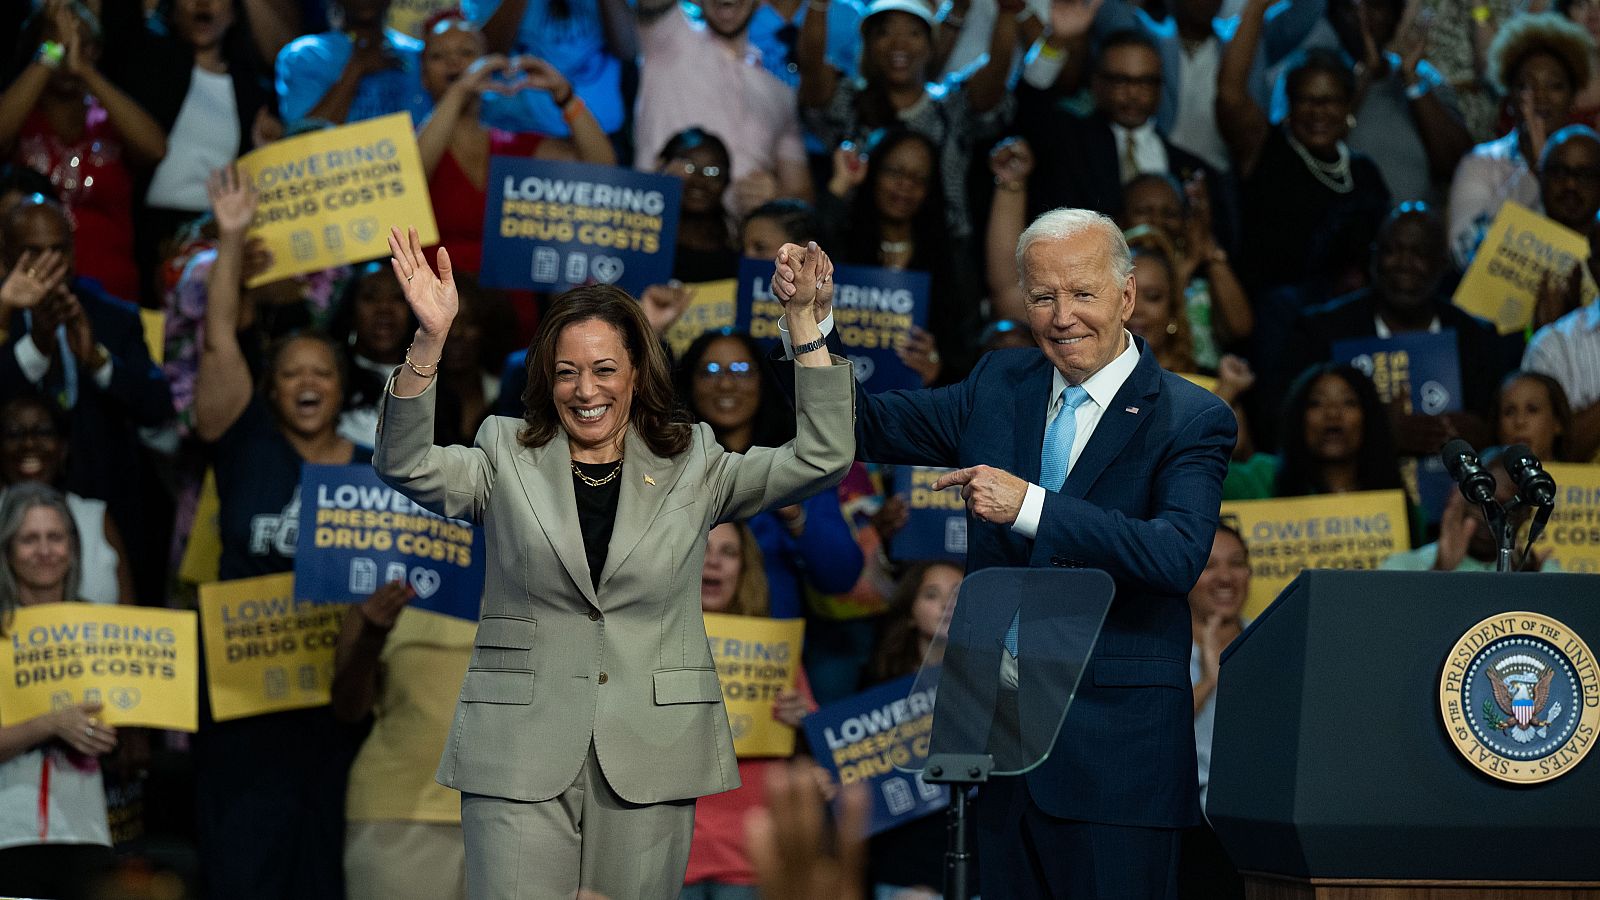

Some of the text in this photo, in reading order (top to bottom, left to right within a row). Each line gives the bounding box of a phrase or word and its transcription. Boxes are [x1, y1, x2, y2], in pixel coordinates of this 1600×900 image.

[324, 181, 405, 211] COSTS
[503, 175, 665, 216] LOWERING
[503, 201, 662, 231] PRESCRIPTION
[501, 217, 660, 254] DRUG COSTS
[317, 508, 474, 545] PRESCRIPTION
[1250, 512, 1391, 544] OWERING
[315, 527, 472, 567] DRUG COSTS
[13, 622, 176, 649] LOWERING
[226, 635, 298, 663] DRUG
[14, 642, 177, 666] PRESCRIPTION
[15, 658, 176, 688] DRUG COSTS
[1446, 618, 1600, 775] SEAL OF THE PRESIDENT OF THE UNITED STATES
